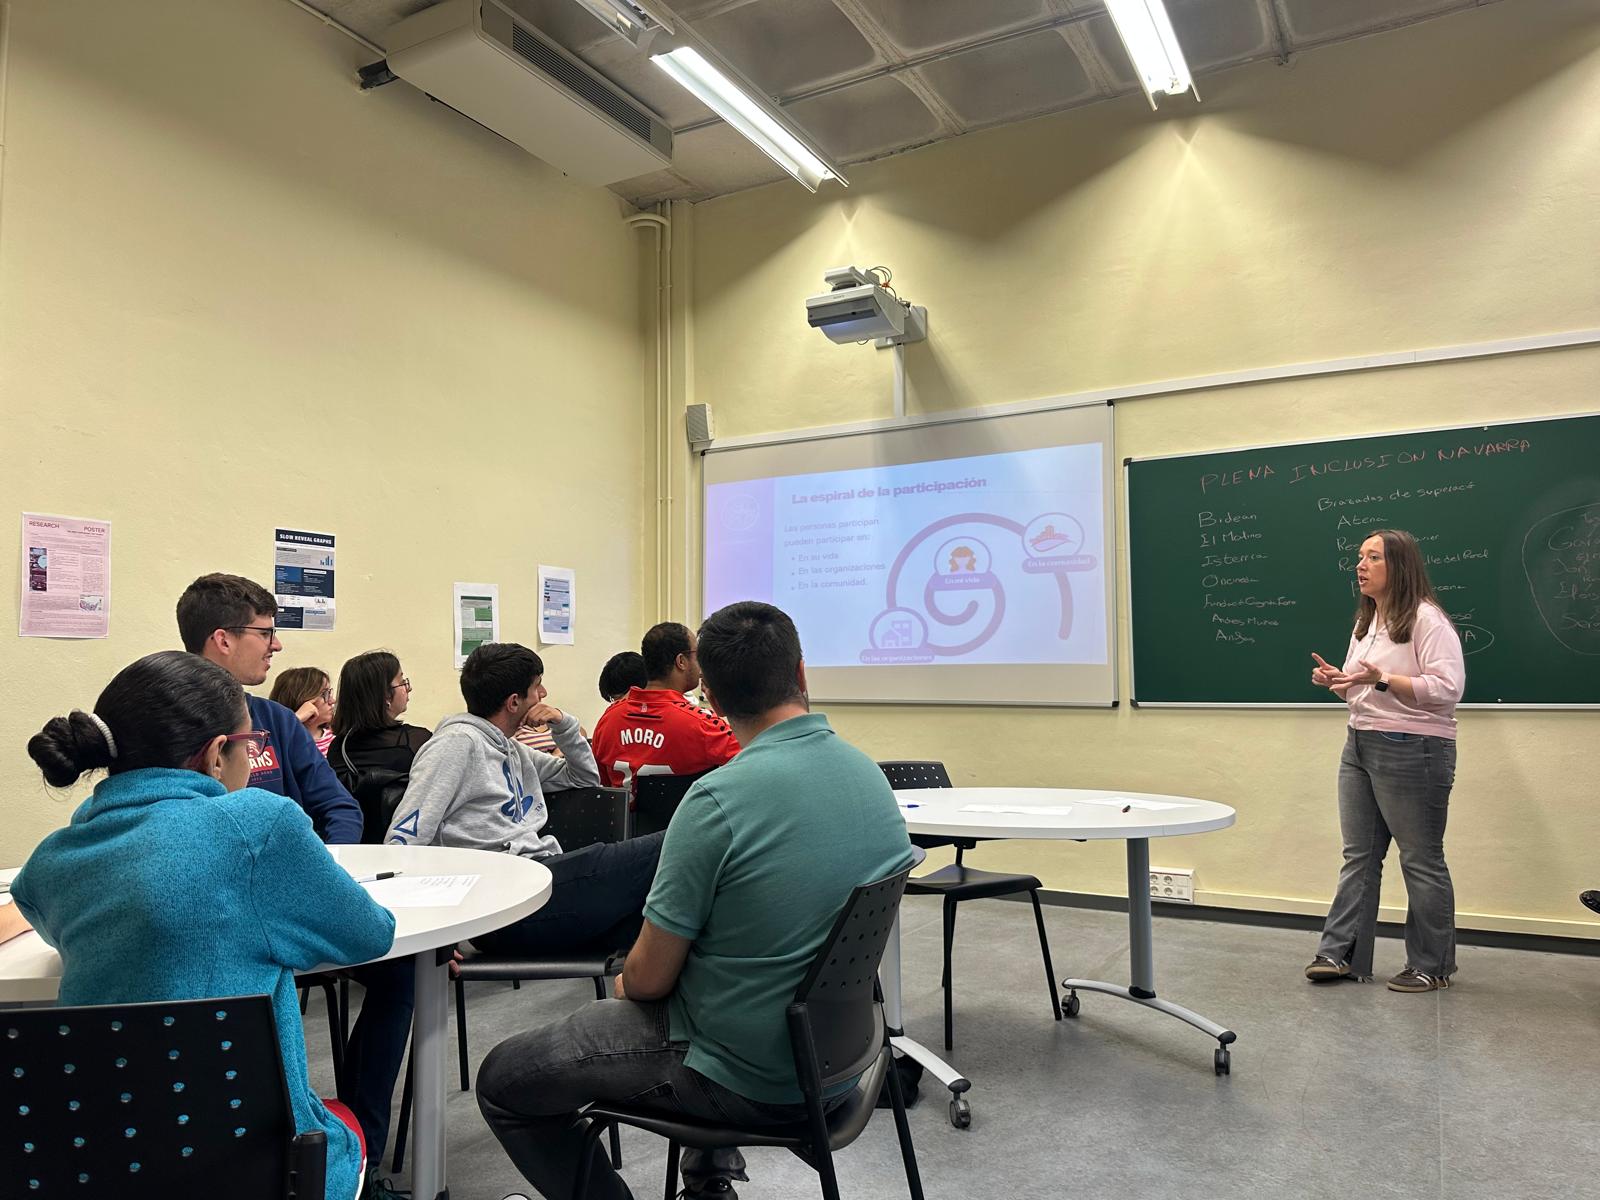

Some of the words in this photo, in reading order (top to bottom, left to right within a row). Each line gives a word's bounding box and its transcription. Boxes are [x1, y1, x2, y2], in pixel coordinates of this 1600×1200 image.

[1200, 465, 1275, 494] PLENA
[1288, 451, 1425, 484] INCLUSION
[1437, 439, 1530, 461] NAVARRA
[792, 494, 808, 504] La
[810, 489, 855, 504] espiral
[857, 488, 875, 498] de
[877, 486, 890, 497] la
[893, 477, 987, 497] participación
[1389, 488, 1412, 500] de
[28, 520, 60, 529] RESEARCH
[83, 526, 106, 534] POSTER
[799, 522, 837, 532] personas
[294, 535, 313, 543] REVEAL
[784, 538, 814, 547] pueden
[816, 534, 854, 544] participar
[822, 552, 839, 560] vida
[798, 567, 809, 575] En
[811, 566, 823, 574] las
[824, 563, 886, 575] organizaciones
[798, 581, 809, 589] En
[811, 580, 818, 588] la
[620, 727, 665, 749] MORO
[249, 751, 273, 769] ANS
